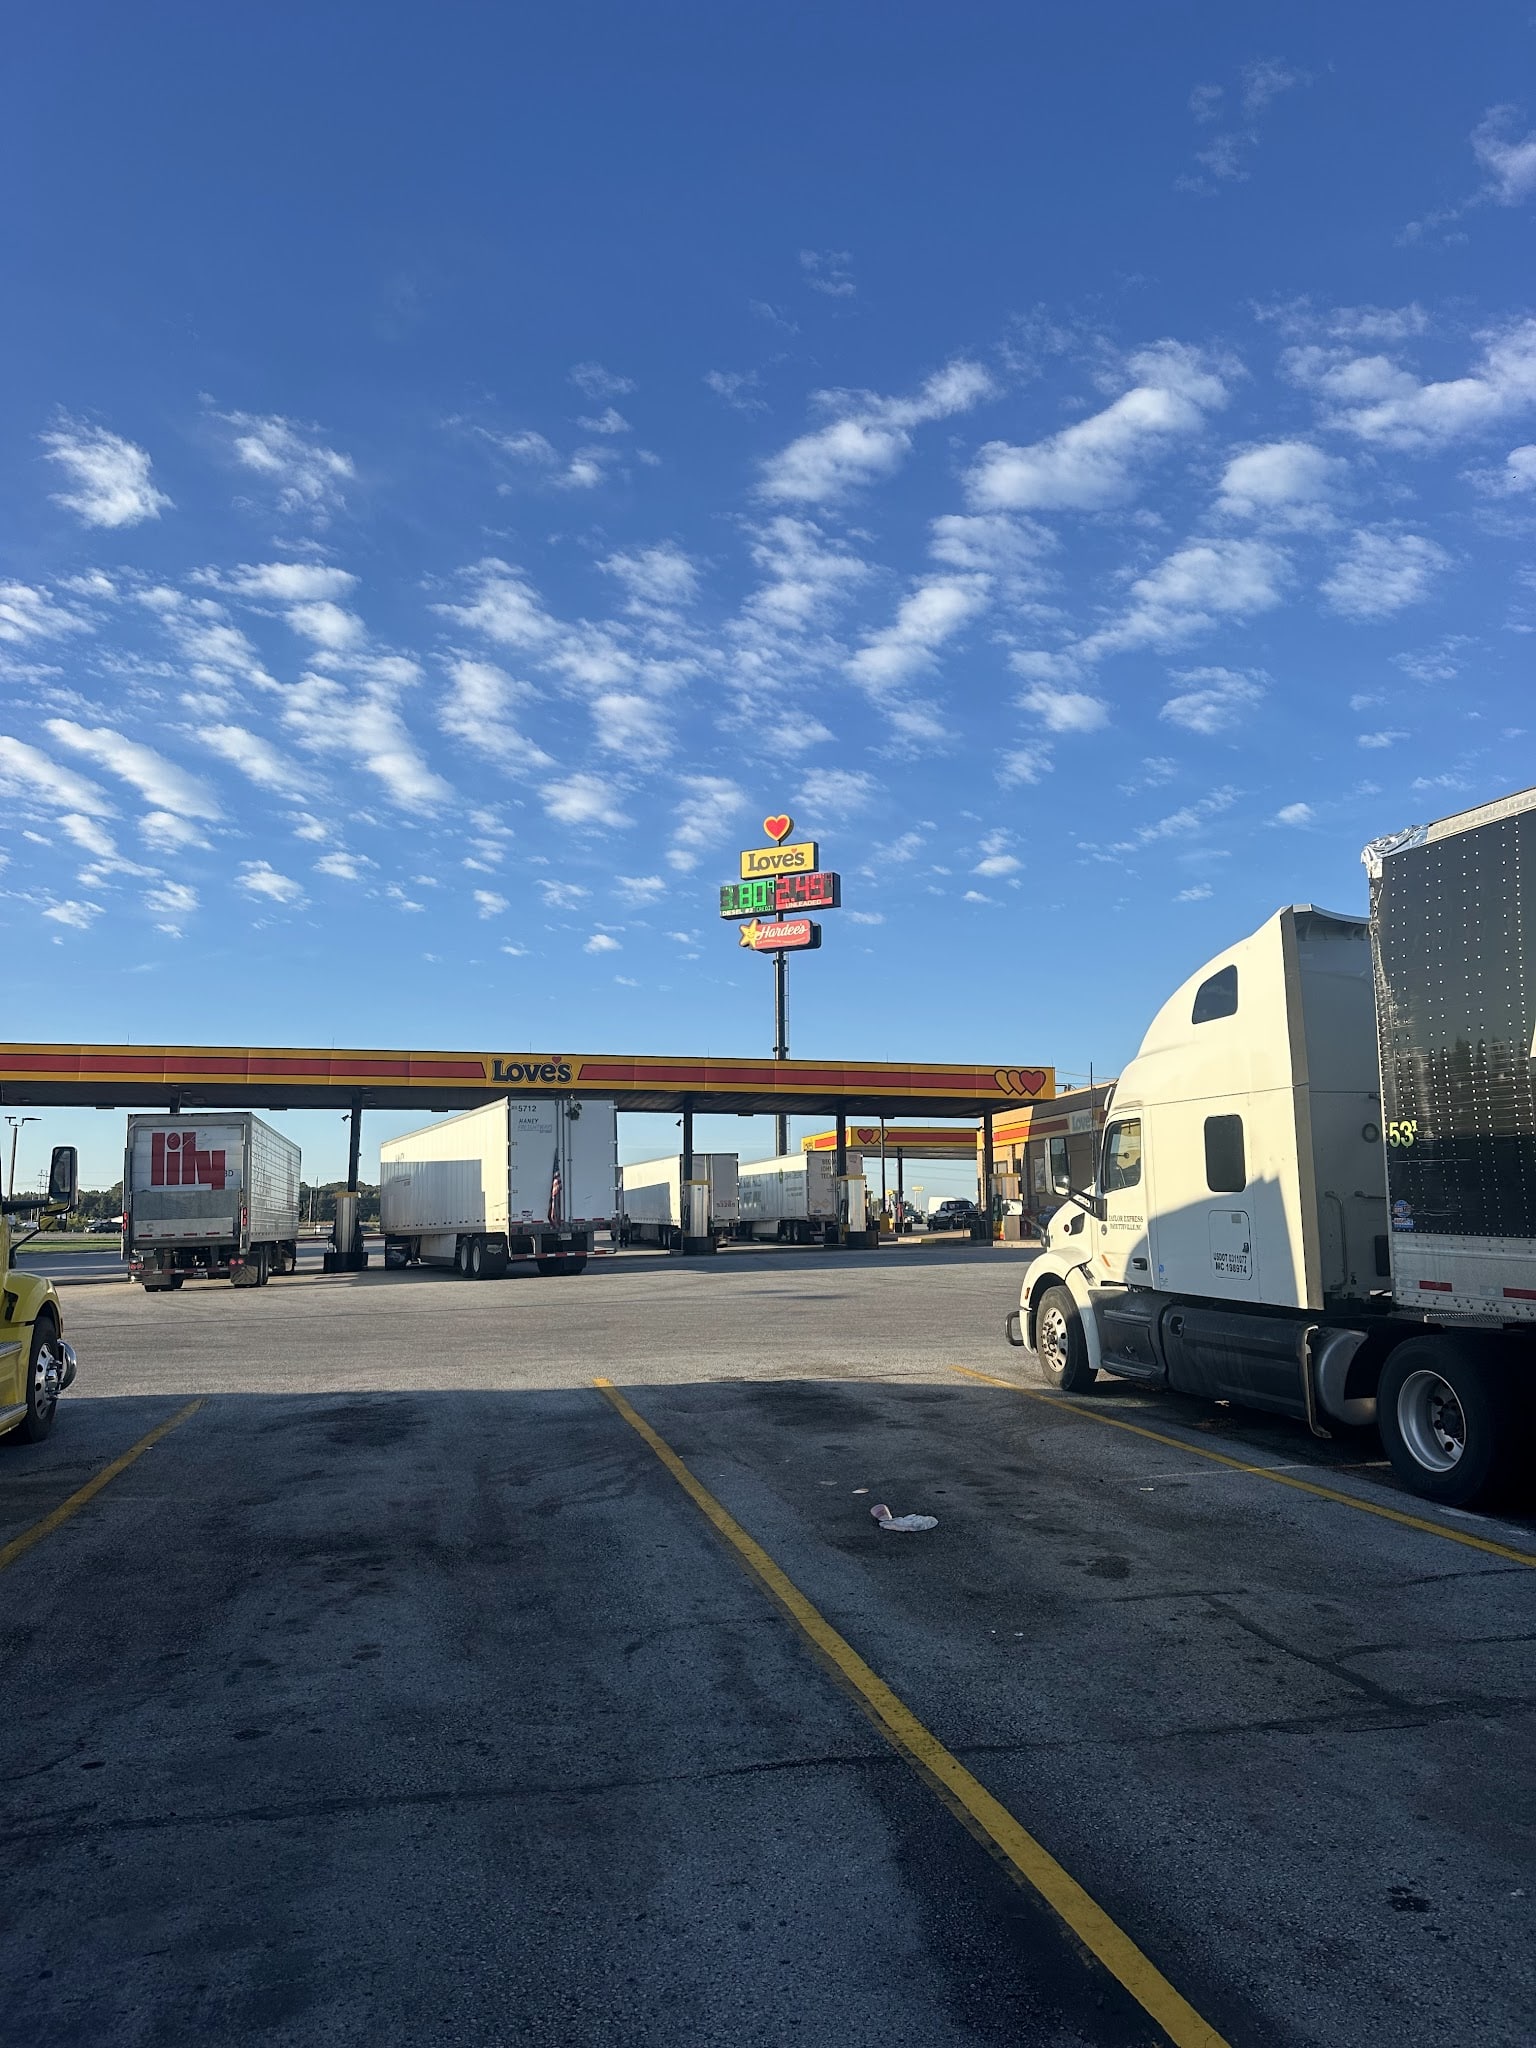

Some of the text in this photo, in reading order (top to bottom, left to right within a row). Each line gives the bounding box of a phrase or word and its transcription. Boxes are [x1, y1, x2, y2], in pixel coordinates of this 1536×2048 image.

[785, 899, 822, 909] UNLEADED
[721, 908, 743, 917] DIESEL
[756, 904, 774, 913] CREDIT
[754, 923, 808, 941] Hardee's
[518, 1104, 537, 1113] 5712
[151, 1132, 226, 1191] lily
[1123, 1215, 1144, 1223] EXPRESS
[1213, 1252, 1228, 1262] USDOT
[1215, 1261, 1225, 1271] MC
